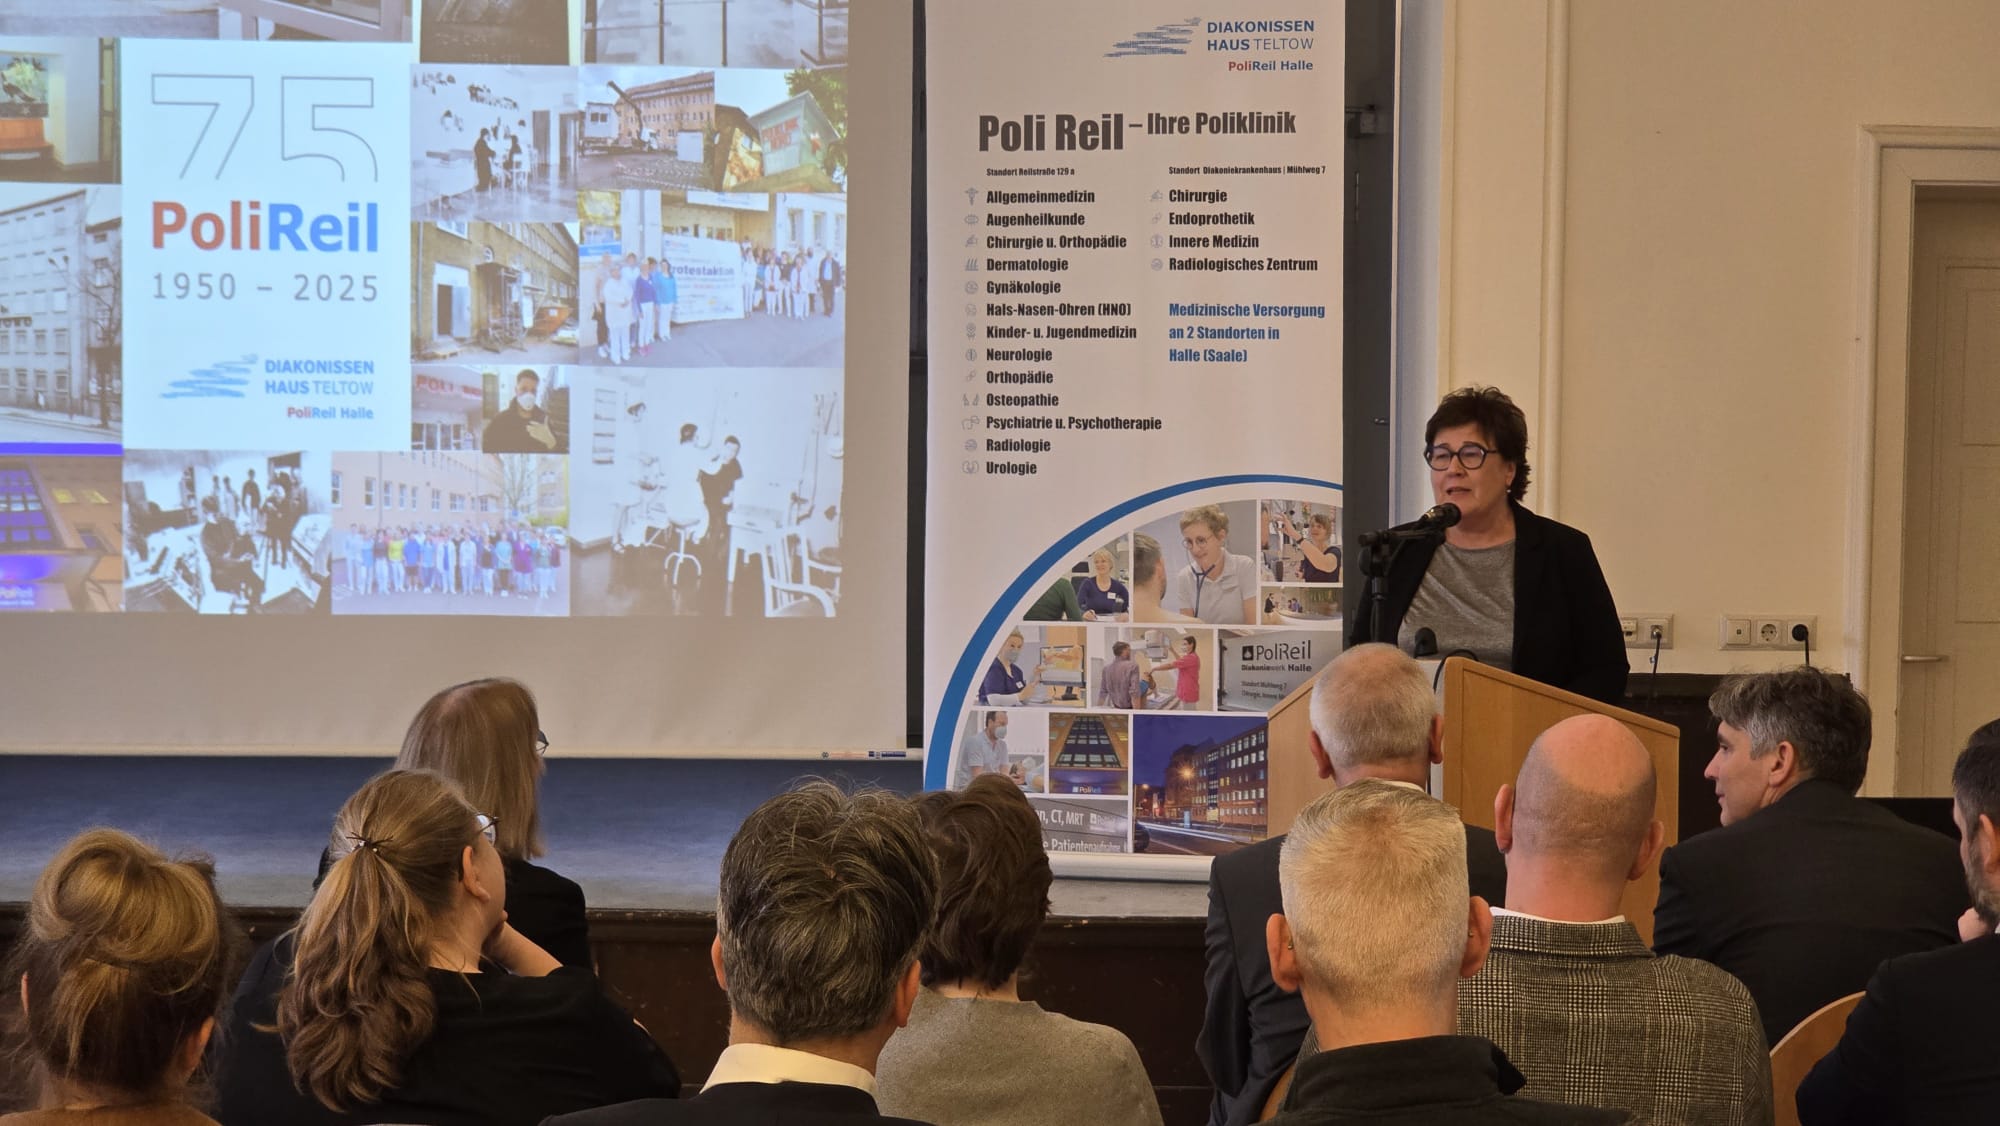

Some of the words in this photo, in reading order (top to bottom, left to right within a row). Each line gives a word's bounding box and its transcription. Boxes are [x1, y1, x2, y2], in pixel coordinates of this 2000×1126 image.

[1207, 21, 1314, 33] DIAKONISSEN
[1207, 39, 1250, 51] HAUS
[1254, 38, 1313, 50] TELTOW
[1228, 61, 1276, 71] PoliReil
[1280, 60, 1313, 70] Halle
[152, 74, 379, 182] 75
[979, 115, 1045, 151] Poli
[1055, 113, 1123, 151] Reil
[1148, 112, 1190, 135] Ihre
[1196, 111, 1296, 134] Poliklinik
[987, 168, 1018, 176] Standort
[1169, 166, 1200, 175] Standort
[1203, 166, 1281, 175] Diakoniekrankenhaus
[1288, 165, 1320, 175] Mühlweg
[1321, 166, 1325, 174] 7
[987, 190, 1095, 205] Allgemeinmedizin
[1169, 190, 1227, 204] Chirurgie
[152, 201, 378, 252] PoliReil
[987, 213, 1085, 227] Augenheilkunde
[1169, 213, 1255, 227] Endoprothetik
[987, 235, 1044, 249] Chirurgie
[1046, 238, 1056, 248] u.
[1059, 235, 1126, 250] Orthopädie
[1169, 235, 1210, 248] Innere
[1212, 235, 1259, 248] Medizin
[671, 265, 734, 276] rotestaktion
[987, 258, 1068, 272] Dermatologie
[1169, 258, 1265, 272] Radiologisches
[1267, 258, 1317, 271] Zentrum
[152, 273, 236, 300] 1950
[294, 274, 378, 301] 2025
[987, 281, 1061, 295] Gynäkologie
[987, 303, 1095, 316] Hals-Nasen-Ohren
[1098, 303, 1131, 317] (HNO)
[1169, 304, 1250, 317] Medizinische
[1253, 304, 1325, 318] Versorgung
[987, 326, 1031, 339] Kinder-
[1034, 329, 1044, 339] u.
[1046, 326, 1136, 341] Jugendmedizin
[1169, 329, 1183, 339] an
[1187, 327, 1194, 339] 2
[1197, 326, 1265, 340] Standorten
[1268, 327, 1279, 340] in
[987, 349, 1052, 362] Neurologie
[1169, 349, 1199, 362] Halle
[1204, 349, 1247, 363] (Saale)
[265, 359, 374, 374] DIAKONISSEN
[987, 371, 1053, 386] Orthopädie
[265, 380, 310, 394] HAUS
[313, 381, 374, 395] TELTOW
[987, 394, 1059, 408] Osteopathie
[287, 407, 336, 419] PoliReil
[340, 407, 374, 419] Halle
[987, 416, 1052, 430] Psychiatrie
[1056, 419, 1066, 429] u.
[1069, 417, 1162, 431] Psychotherapie
[987, 439, 1051, 453] Radiologie
[987, 462, 1037, 476] Urologie
[1288, 664, 1312, 672] Halle
[1051, 809, 1064, 826] CT,
[1066, 811, 1084, 826] MRT
